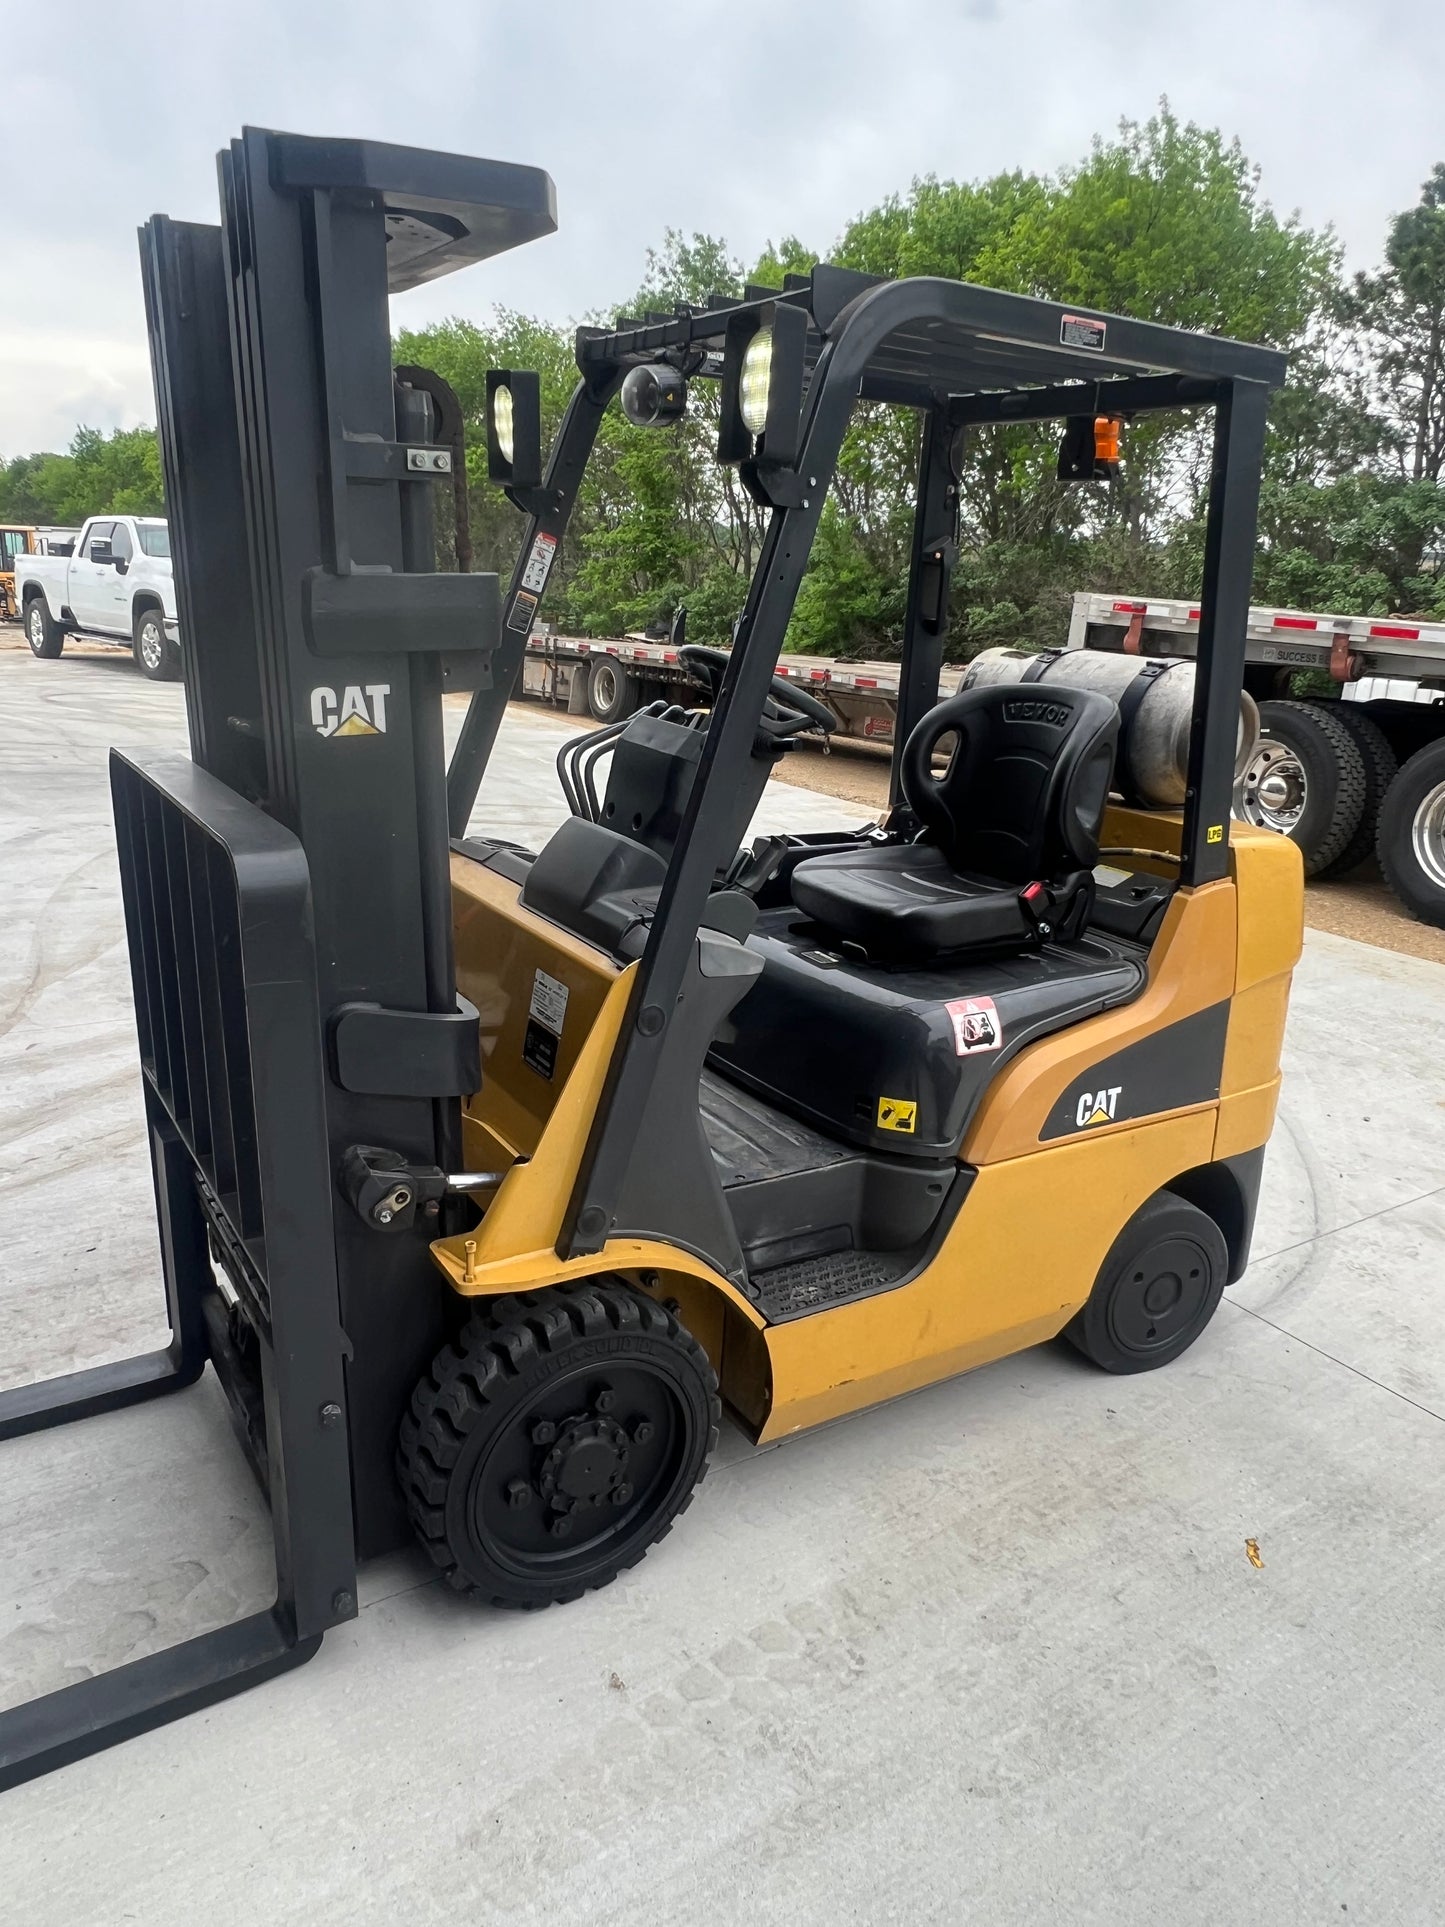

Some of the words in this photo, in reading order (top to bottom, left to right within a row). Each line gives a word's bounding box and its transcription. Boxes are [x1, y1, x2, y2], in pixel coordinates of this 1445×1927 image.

[1277, 650, 1317, 663] SUCCESS
[310, 684, 391, 738] CAT
[1208, 828, 1222, 840] LPG
[1076, 1086, 1122, 1127] CAT
